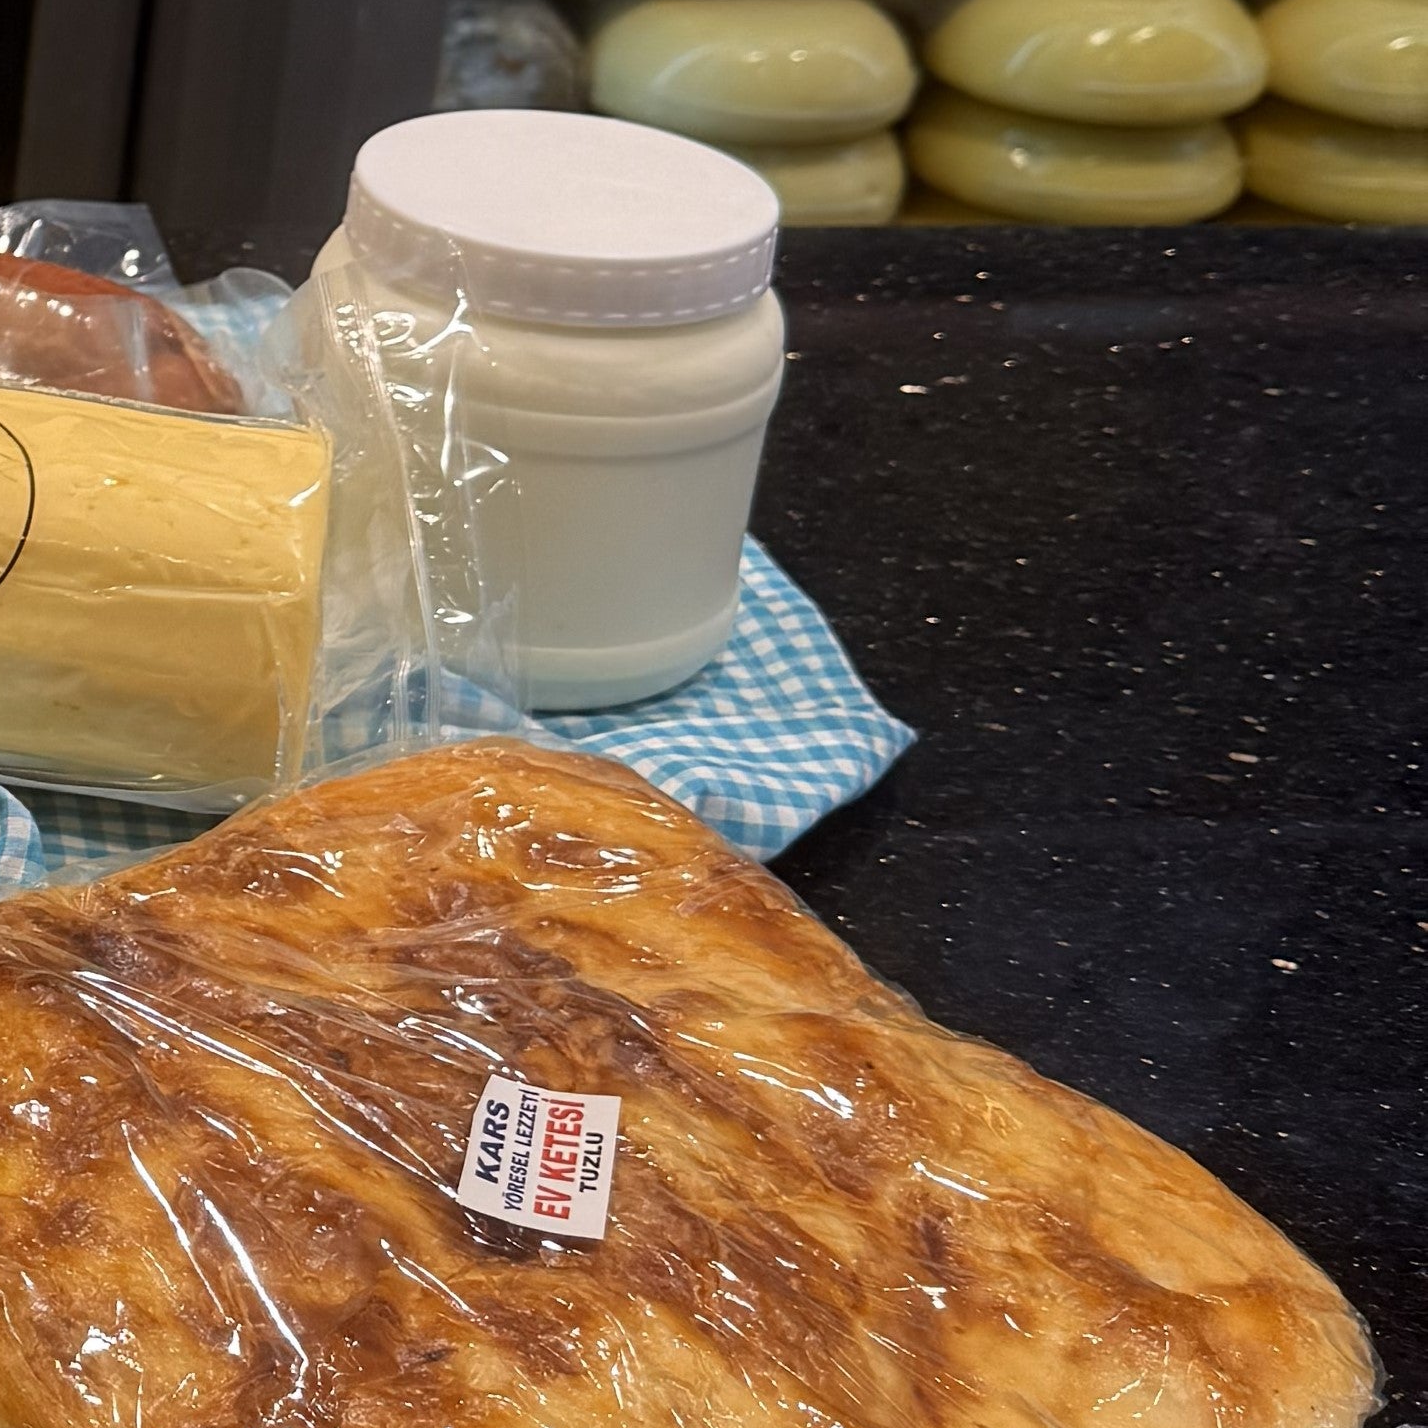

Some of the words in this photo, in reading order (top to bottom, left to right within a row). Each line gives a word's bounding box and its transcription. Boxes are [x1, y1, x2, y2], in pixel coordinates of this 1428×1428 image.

[475, 1100, 509, 1184] KARS
[539, 1098, 585, 1182] KETESİ
[579, 1133, 603, 1192] TUZLU
[504, 1151, 529, 1210] YÖRESEL
[534, 1185, 571, 1220] EV
